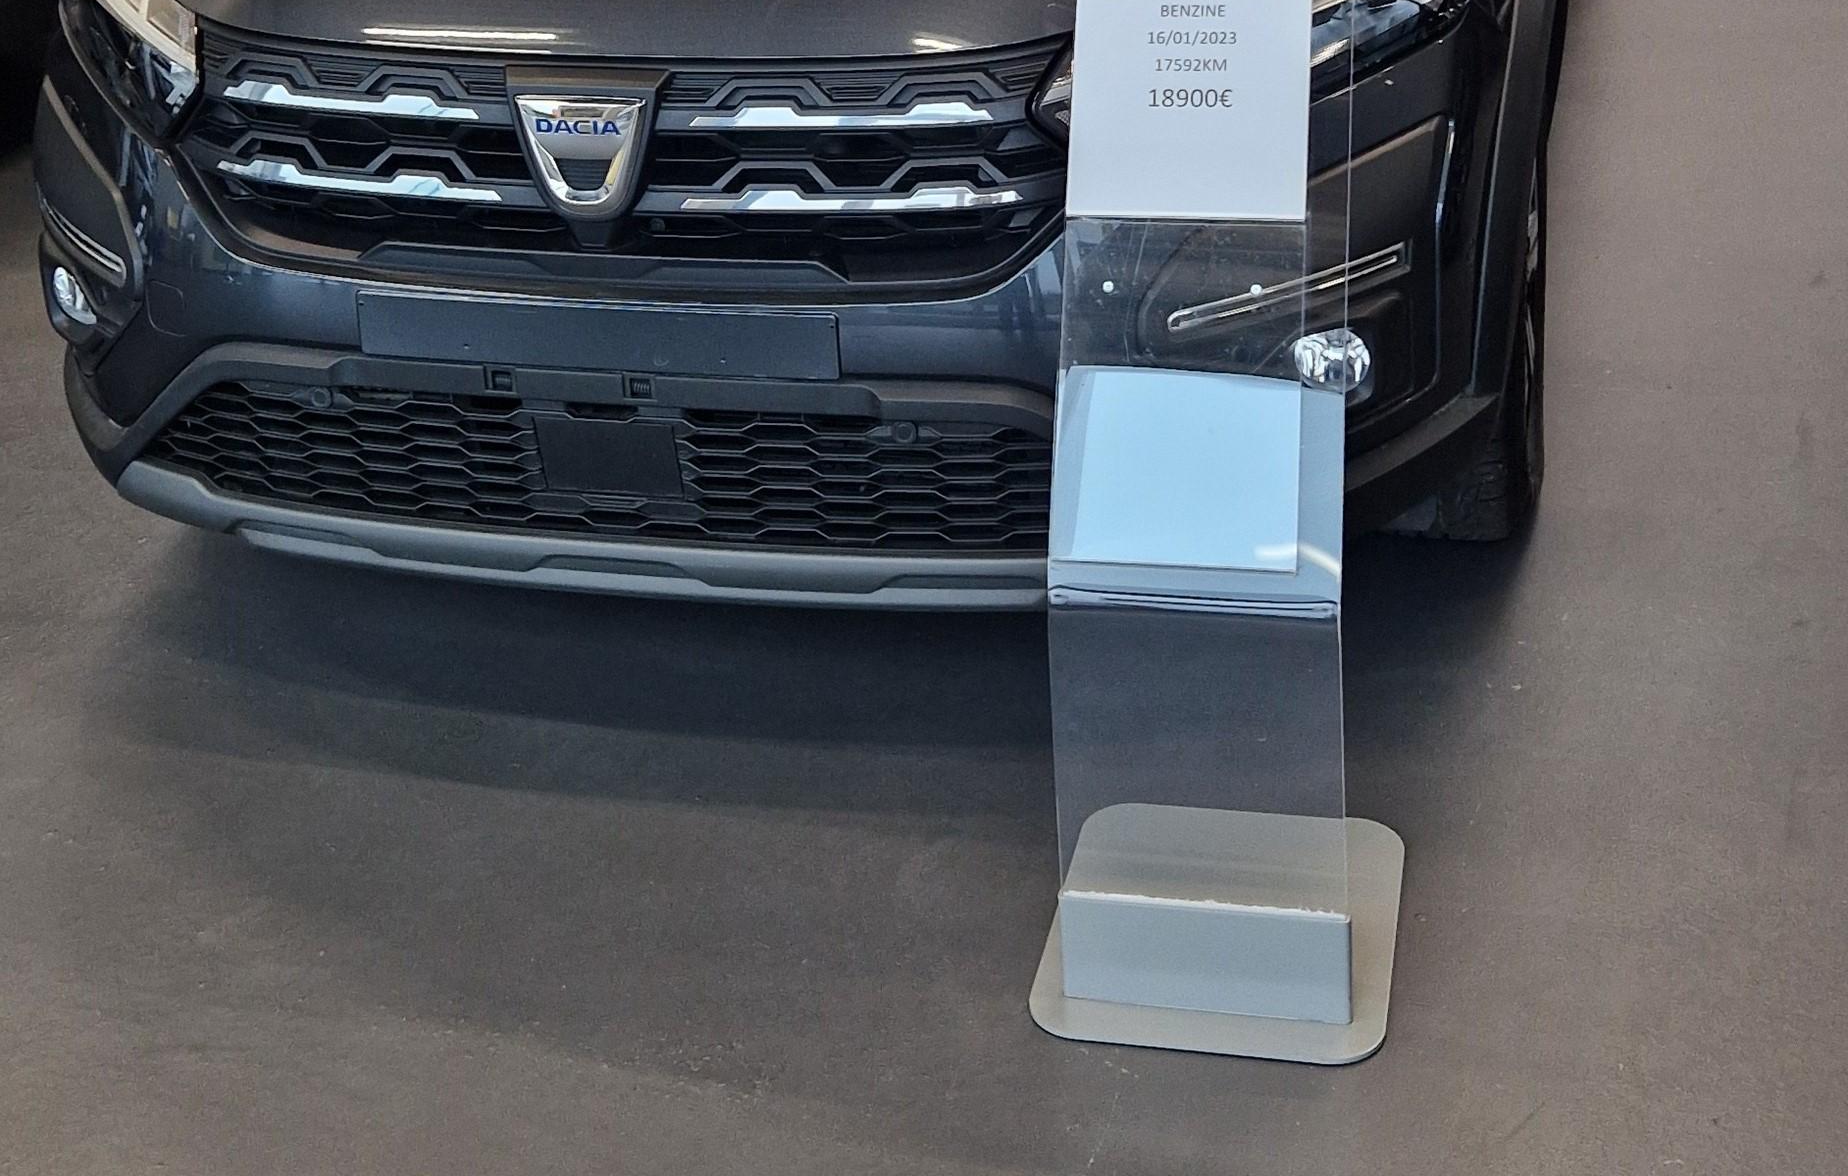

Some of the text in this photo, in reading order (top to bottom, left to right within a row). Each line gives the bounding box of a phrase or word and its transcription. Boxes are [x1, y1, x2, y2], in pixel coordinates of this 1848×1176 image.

[1160, 4, 1226, 18] BENZINE
[1147, 30, 1237, 46] 16/01/2023
[1155, 58, 1227, 72] 17592KM
[1148, 88, 1233, 108] 18900€
[535, 118, 621, 135] DACIA
